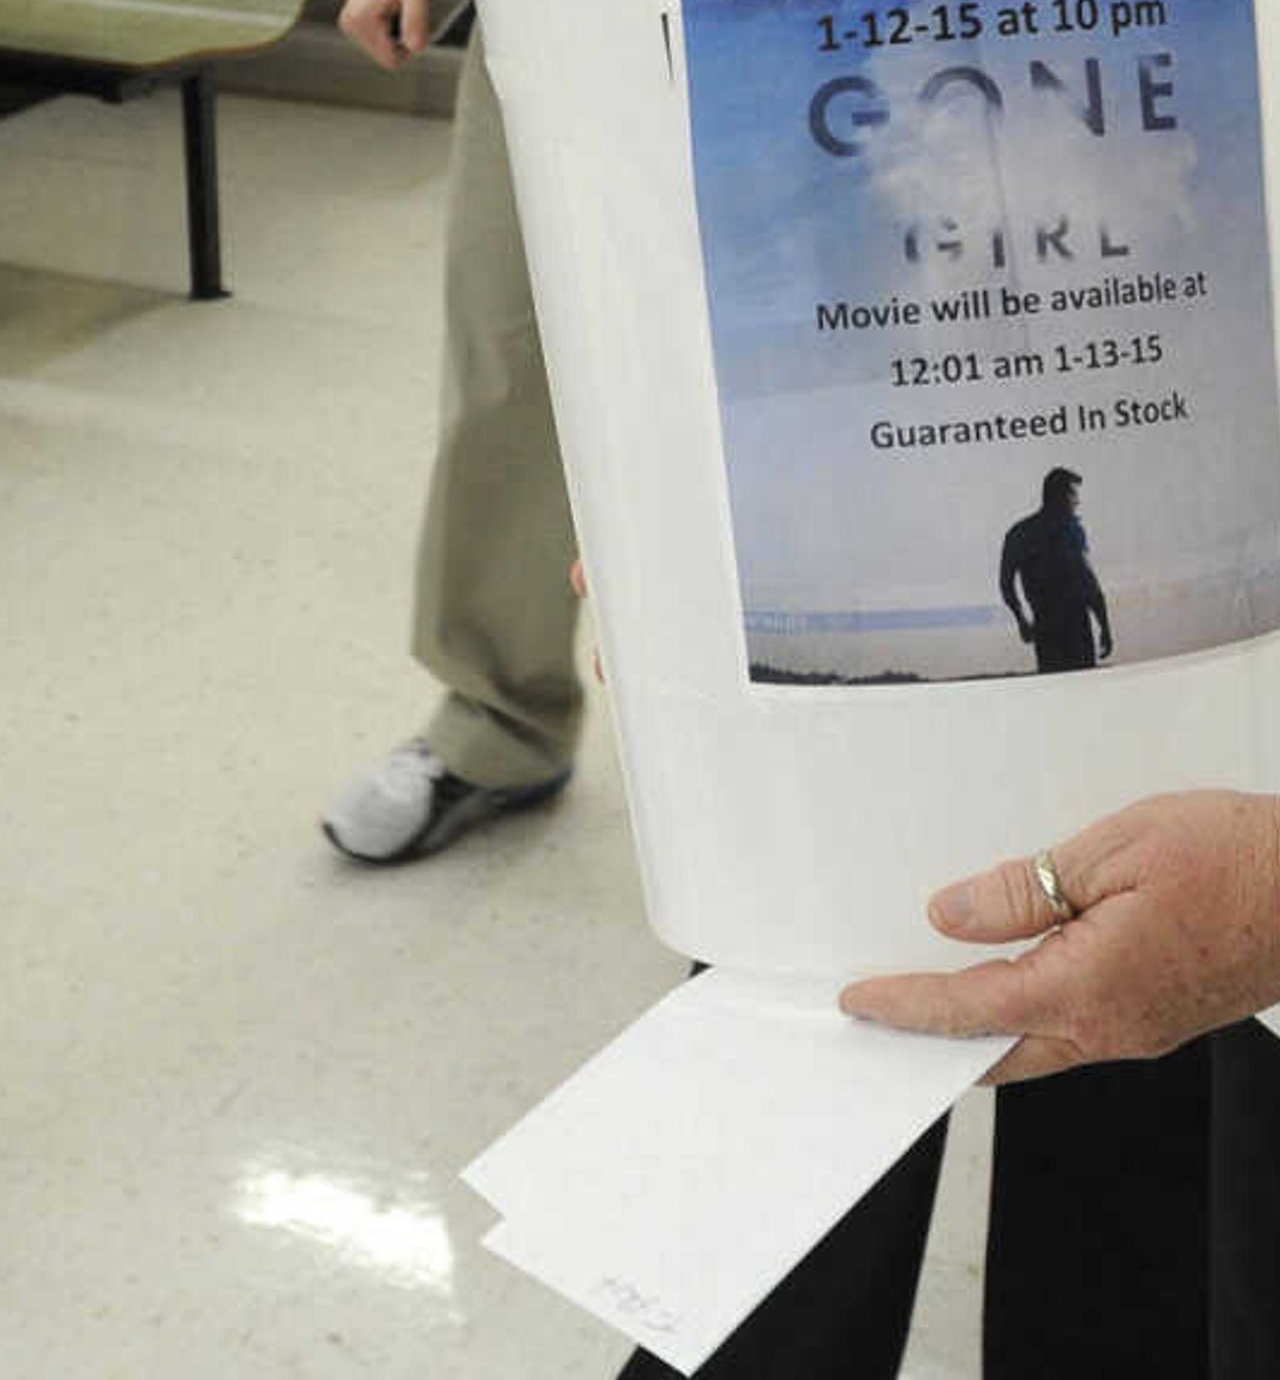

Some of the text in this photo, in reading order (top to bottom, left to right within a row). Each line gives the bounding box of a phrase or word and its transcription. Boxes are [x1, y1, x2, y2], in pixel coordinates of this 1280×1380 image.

[818, 2, 983, 54] 1-12-15
[998, 1, 1039, 35] at
[807, 52, 1180, 158] GONE
[815, 271, 1209, 331] Movie will be available at
[891, 334, 1164, 388] 12:01 am 1-13-15
[870, 391, 1190, 451] Guaranteed In Stock
